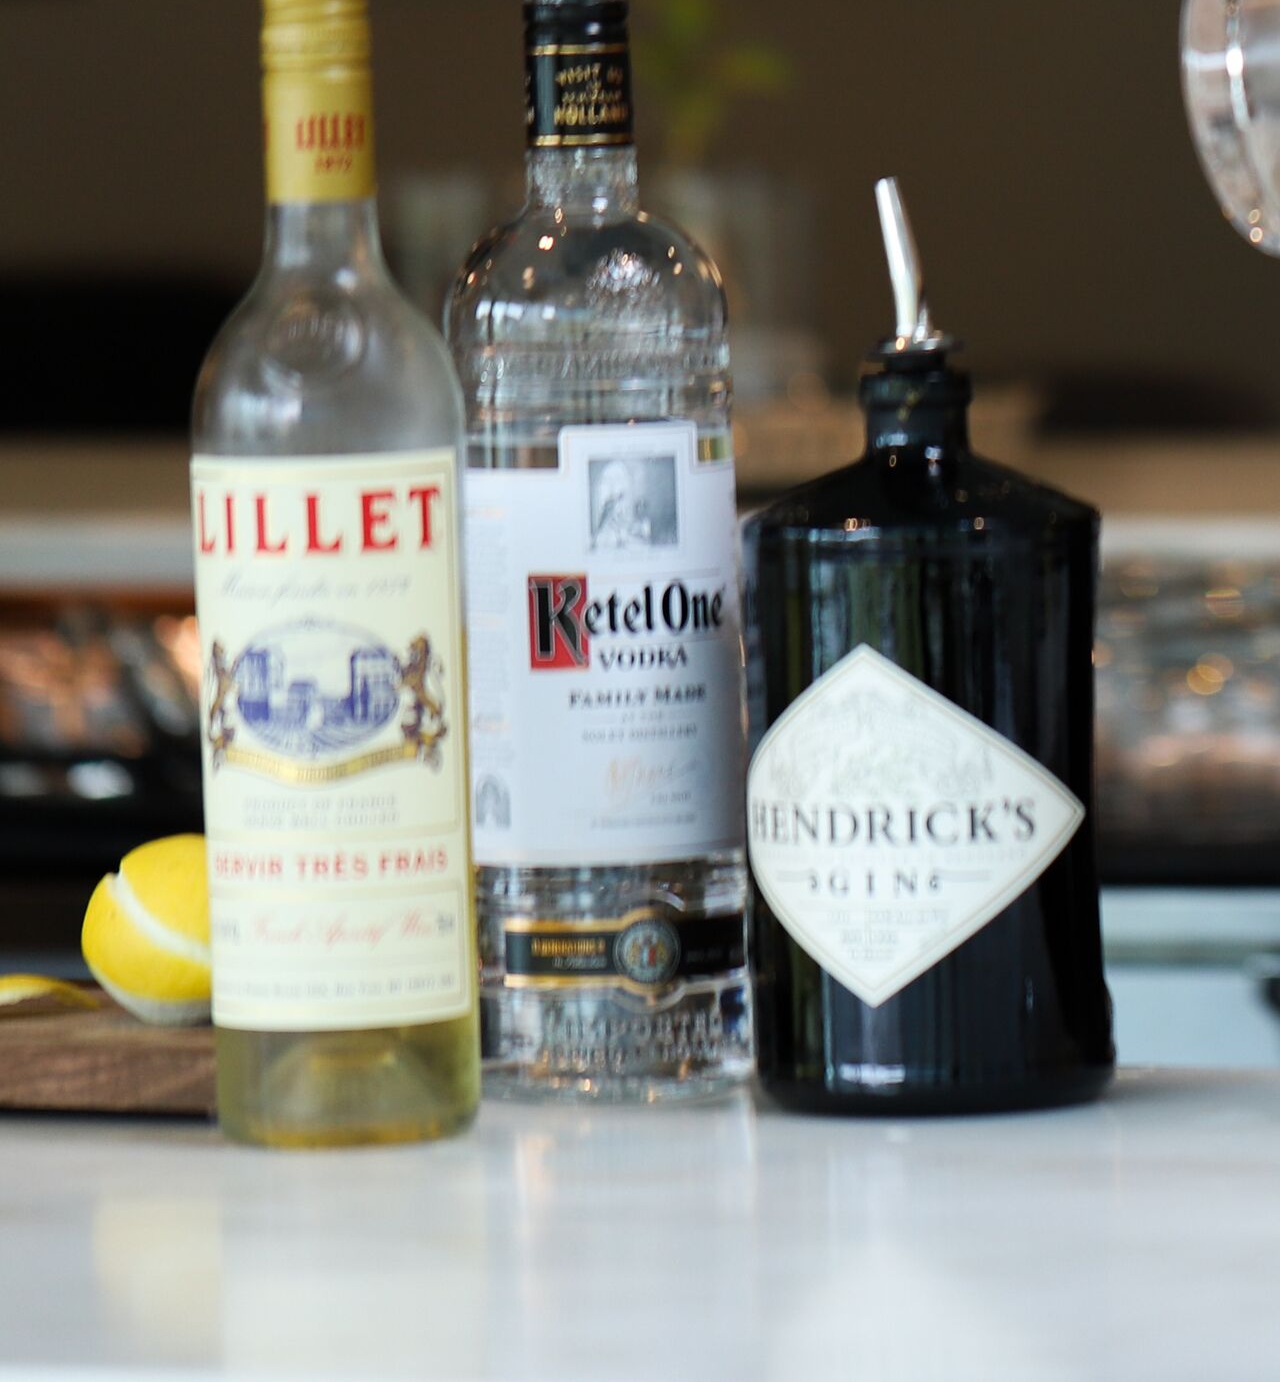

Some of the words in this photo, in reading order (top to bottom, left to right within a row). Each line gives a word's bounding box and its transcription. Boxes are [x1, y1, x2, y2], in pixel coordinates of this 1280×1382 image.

[198, 485, 441, 555] LILLET
[530, 576, 655, 667] Ketel
[661, 579, 724, 632] One
[598, 646, 689, 673] VODKA
[568, 686, 648, 709] FAMILY
[654, 682, 708, 705] MADE
[751, 797, 1037, 848] HENDRICK'S
[296, 848, 369, 881] TRÈS
[377, 844, 449, 876] FRAIS
[828, 869, 919, 900] GIN
